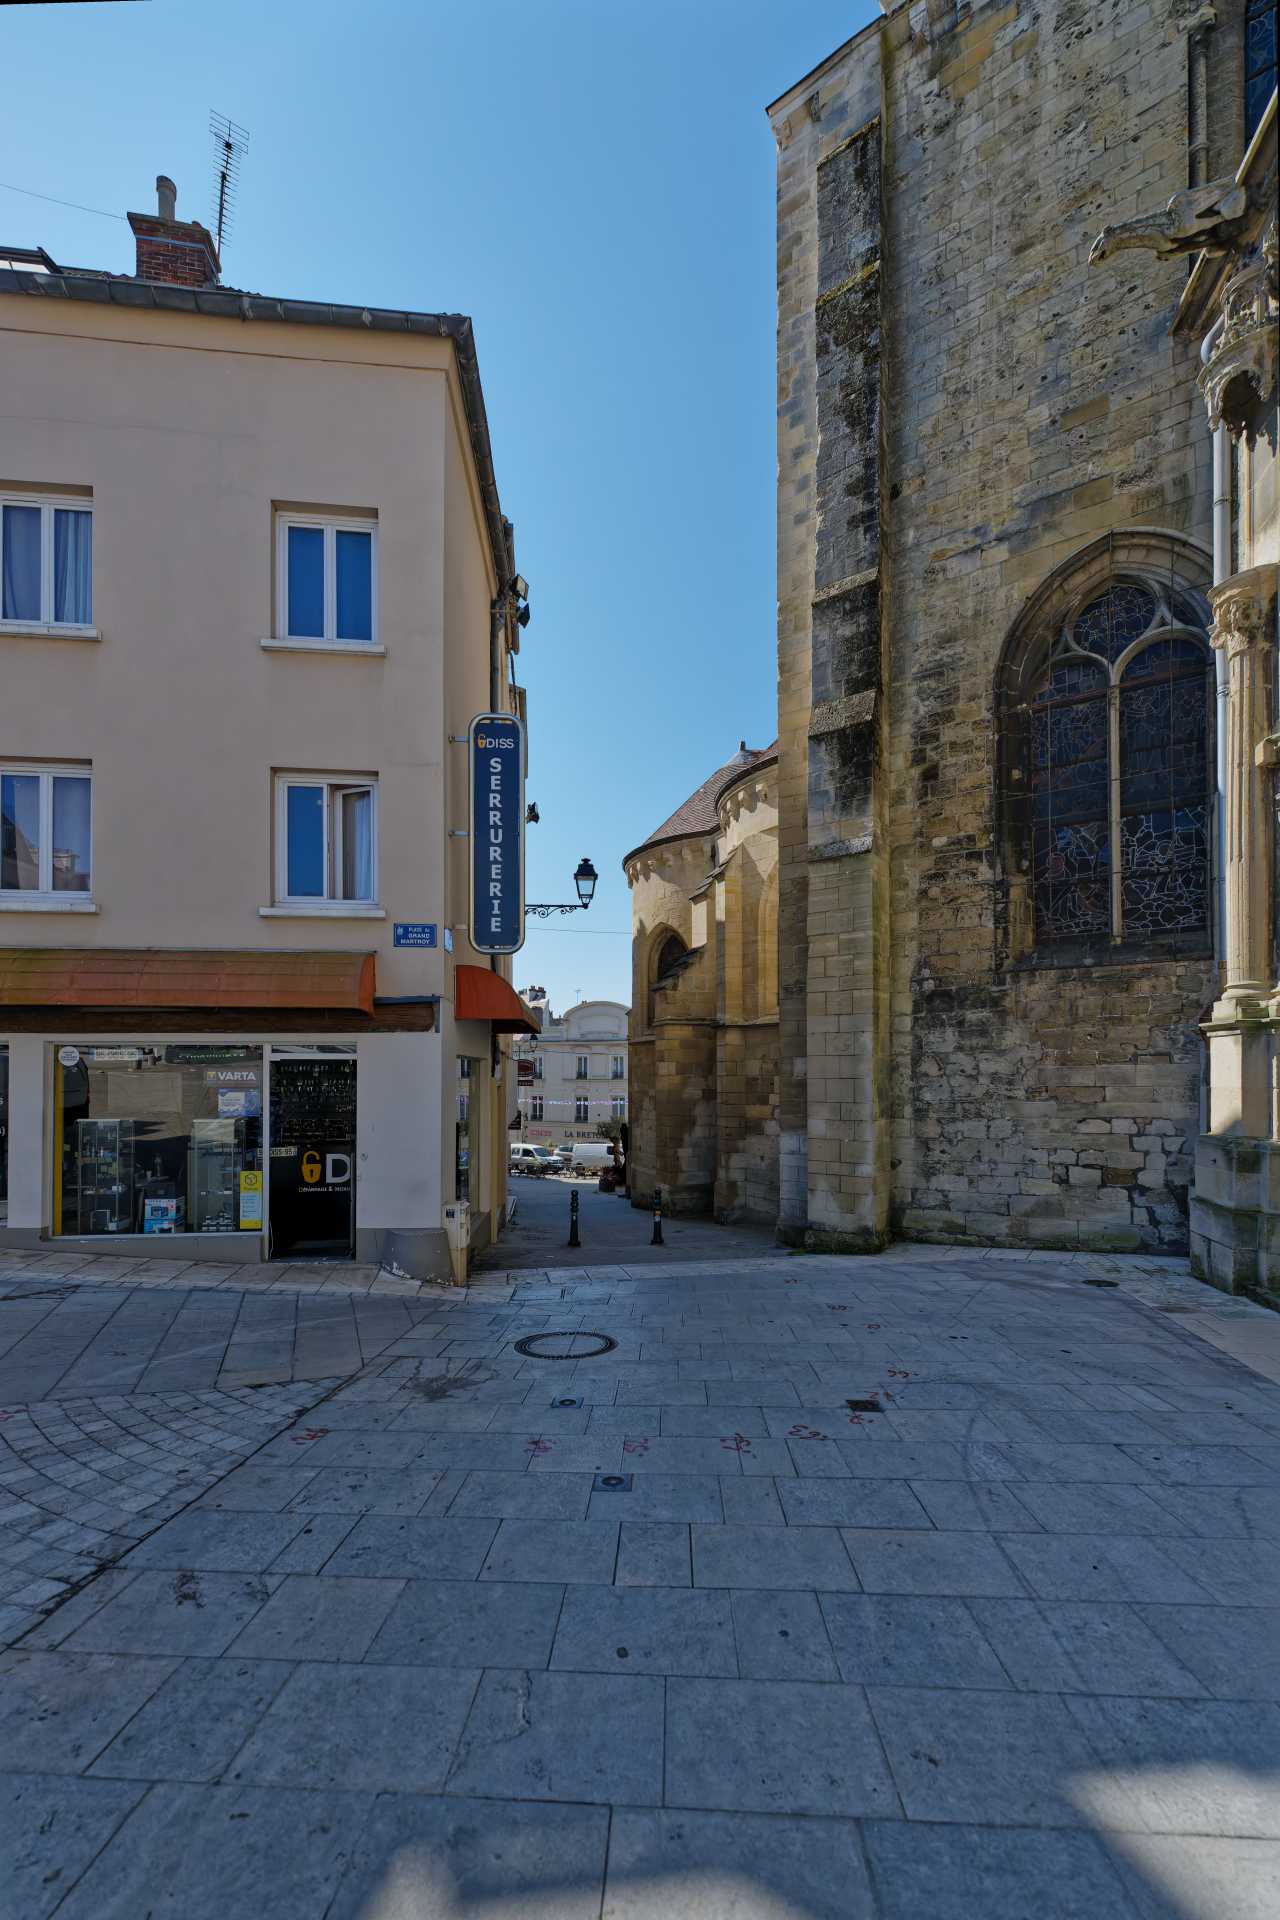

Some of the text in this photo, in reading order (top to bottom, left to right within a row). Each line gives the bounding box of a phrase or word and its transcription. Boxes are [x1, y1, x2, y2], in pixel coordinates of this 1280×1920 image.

[486, 738, 515, 749] DISS
[489, 757, 503, 932] SERRURERIE
[217, 1071, 256, 1081] VARTA
